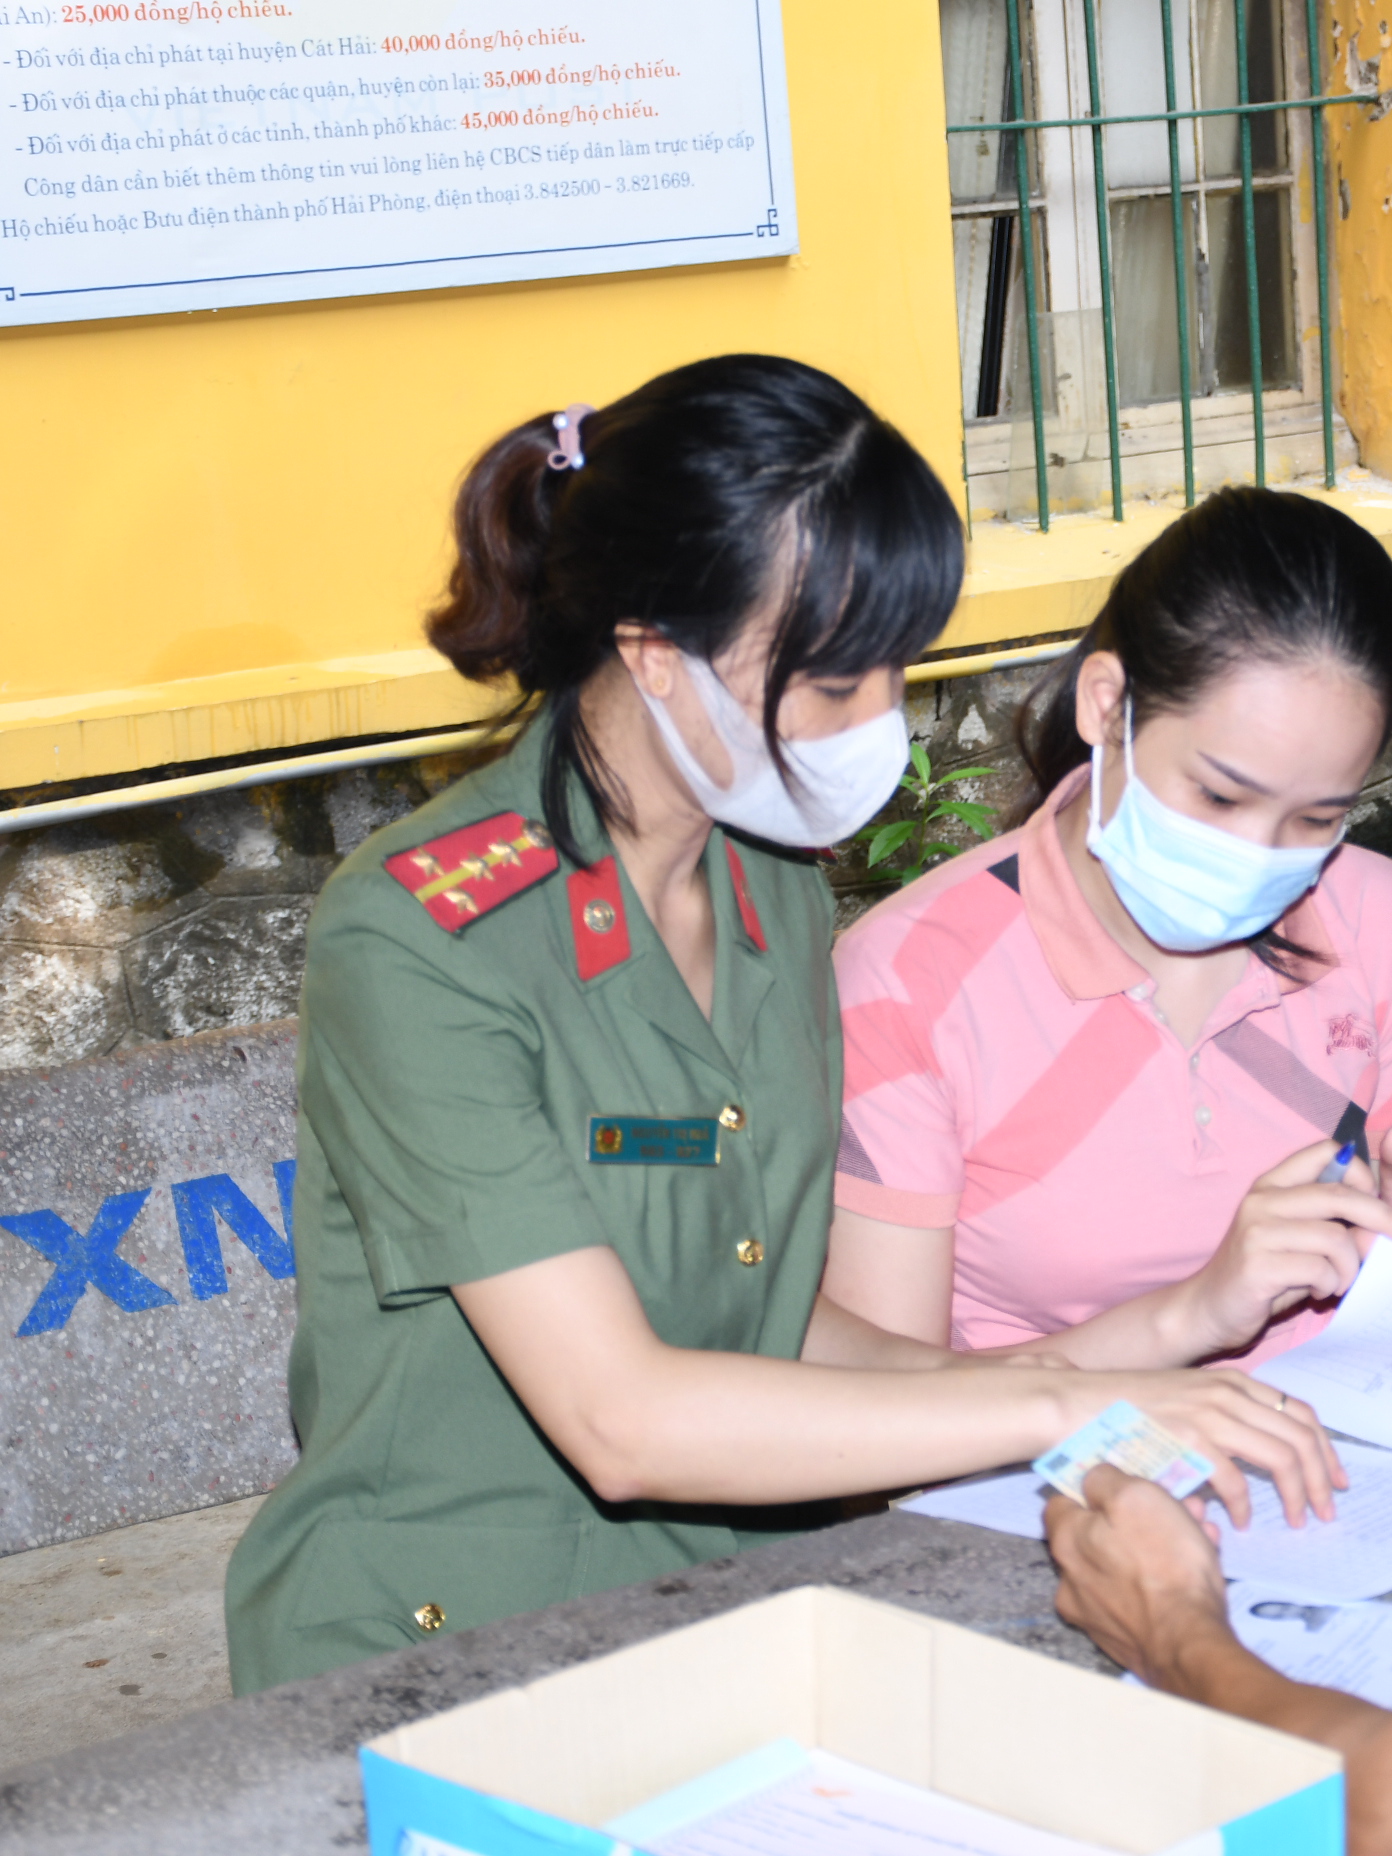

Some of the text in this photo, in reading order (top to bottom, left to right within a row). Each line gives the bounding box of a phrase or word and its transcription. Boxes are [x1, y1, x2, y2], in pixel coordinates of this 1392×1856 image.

[15, 5, 57, 27] An):
[61, 5, 130, 26] 25,000
[16, 47, 51, 69] Đối
[56, 48, 84, 67] với
[90, 47, 121, 69] địa
[125, 44, 153, 65] chỉ
[159, 44, 203, 67] phát
[208, 45, 234, 65] tại
[238, 42, 297, 63] huyện
[301, 38, 334, 58] Cát
[338, 34, 377, 57] Hải:
[380, 34, 441, 56] 40,000
[445, 28, 523, 52] đồng/hộ
[527, 25, 586, 46] chiếu.
[22, 90, 57, 112] Đối
[61, 91, 90, 110] với
[97, 90, 126, 112] địa
[130, 86, 160, 107] chỉ
[164, 86, 208, 110] phát
[212, 84, 266, 106] thuộc
[269, 83, 300, 101] các
[303, 80, 355, 103] quận,
[358, 76, 416, 99] huyện
[418, 75, 449, 93] còn
[452, 72, 480, 92] lại:
[483, 68, 542, 90] 35,000
[545, 63, 621, 86] đồng/hộ
[625, 58, 681, 80] chiếu.
[27, 133, 63, 155] Đối
[67, 133, 97, 152] với
[101, 132, 132, 154] địa
[135, 128, 165, 149] chỉ
[169, 127, 214, 152] phát
[217, 123, 229, 145] ở
[231, 125, 262, 144] các
[265, 121, 311, 143] tỉnh,
[314, 118, 369, 140] thành
[373, 113, 408, 139] phố
[409, 113, 458, 134] khác:
[460, 110, 519, 132] 45,000
[523, 104, 599, 127] đồng/hộ
[602, 99, 659, 121] chiếu.
[24, 130, 755, 198] Công dân cần biết thêm thông tin vui lòng liên hệ CBCS tiếp dân làm trực tiếp cấp
[1, 218, 31, 241] Hộ
[34, 213, 89, 236] chiếu
[93, 213, 139, 234] hoặc
[143, 210, 184, 229] Bưu
[188, 207, 230, 228] điện
[234, 201, 291, 222] thành
[294, 197, 330, 222] phố
[331, 194, 365, 215] Hải
[369, 193, 431, 212] Phòng,
[434, 188, 473, 210] điện
[476, 184, 521, 206] thoại
[524, 178, 601, 200] 3.842500
[616, 172, 696, 194] 3.821669.
